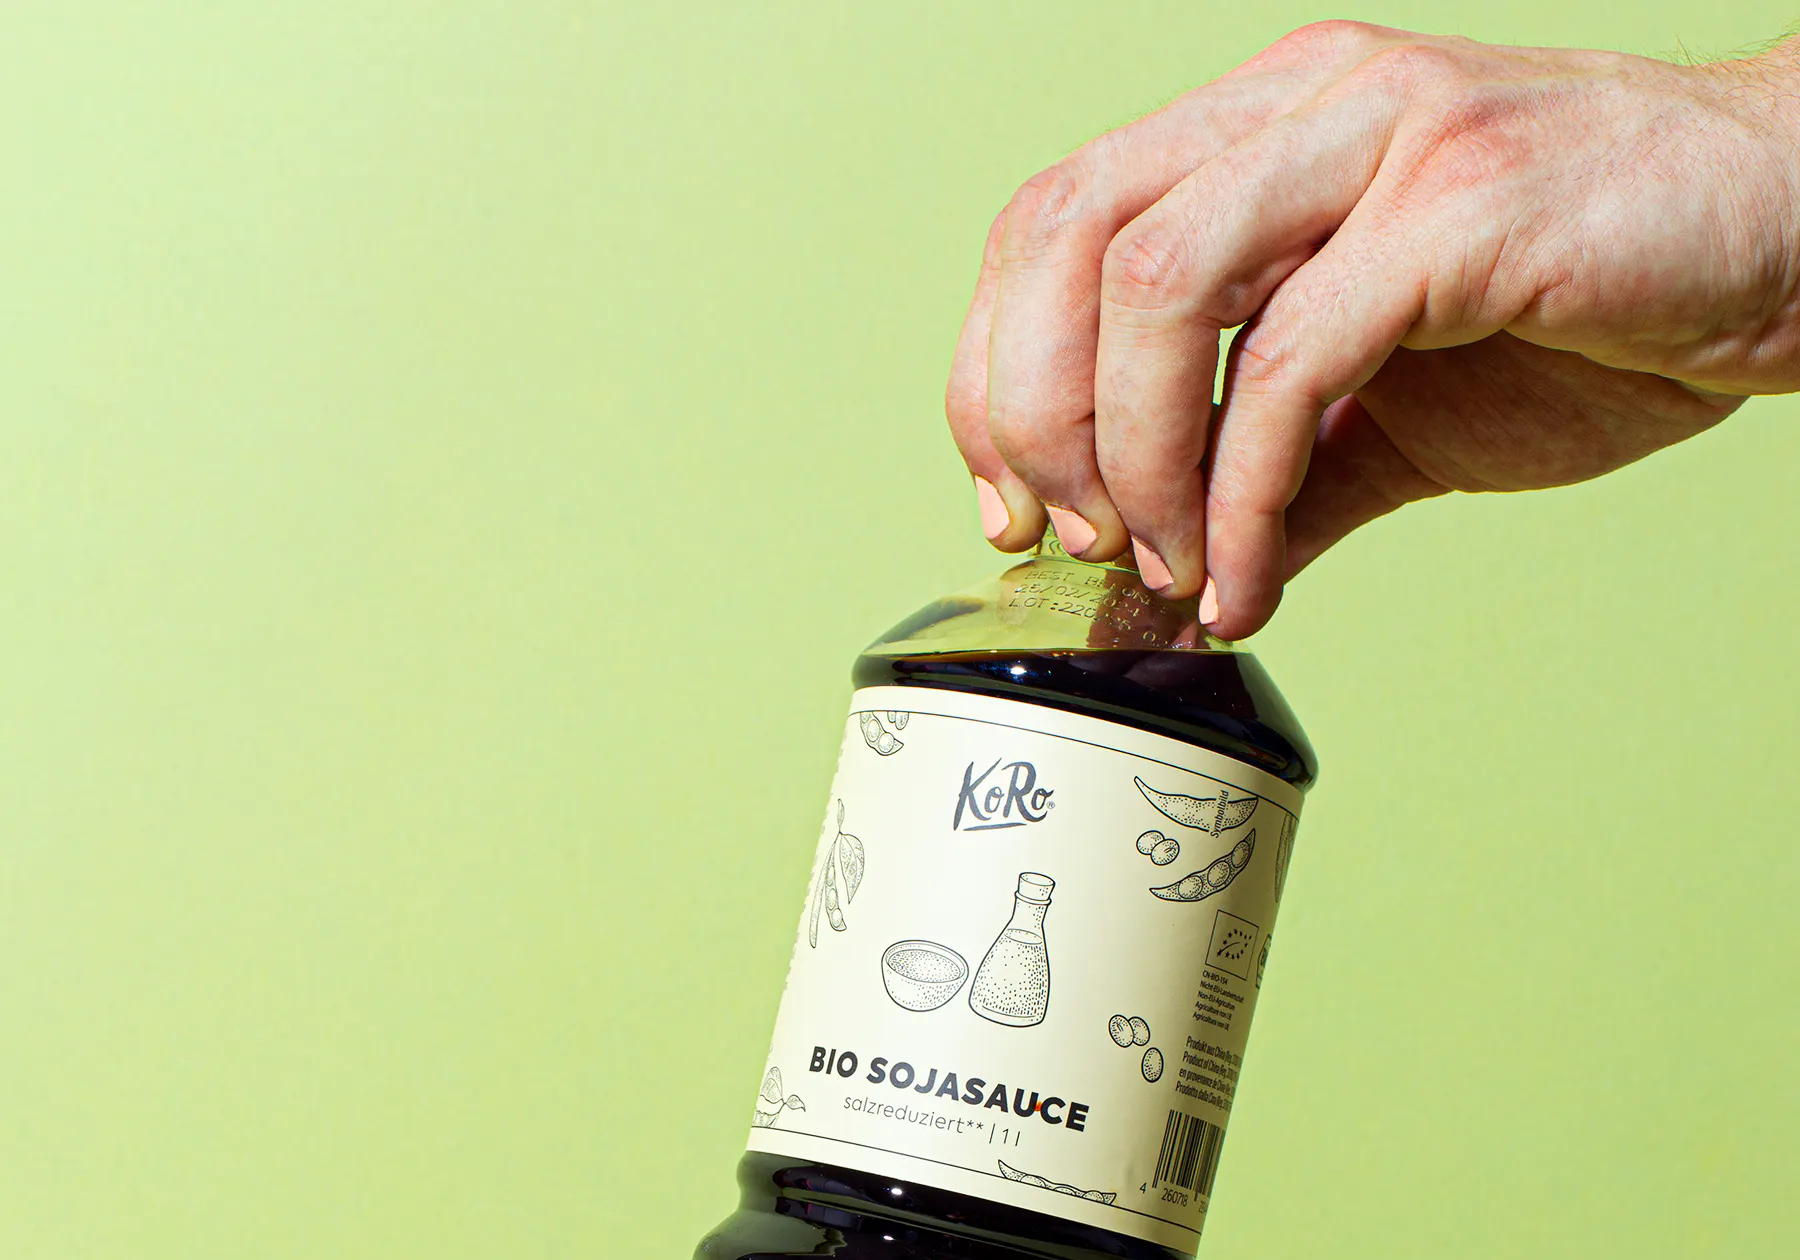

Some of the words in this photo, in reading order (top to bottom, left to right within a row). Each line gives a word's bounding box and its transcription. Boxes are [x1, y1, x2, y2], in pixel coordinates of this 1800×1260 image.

[1024, 571, 1074, 582] BEST
[1210, 789, 1229, 839] Symbolbild
[1186, 1035, 1208, 1053] Produkt
[1206, 1044, 1215, 1056] aus
[1182, 1050, 1204, 1069] Product
[1203, 1058, 1209, 1070] of
[1178, 1068, 1187, 1079] en
[809, 1046, 858, 1078] BIO
[866, 1056, 1090, 1132] SOJASAUCE
[1139, 1182, 1147, 1195] 4
[1161, 1187, 1189, 1207] 260718
